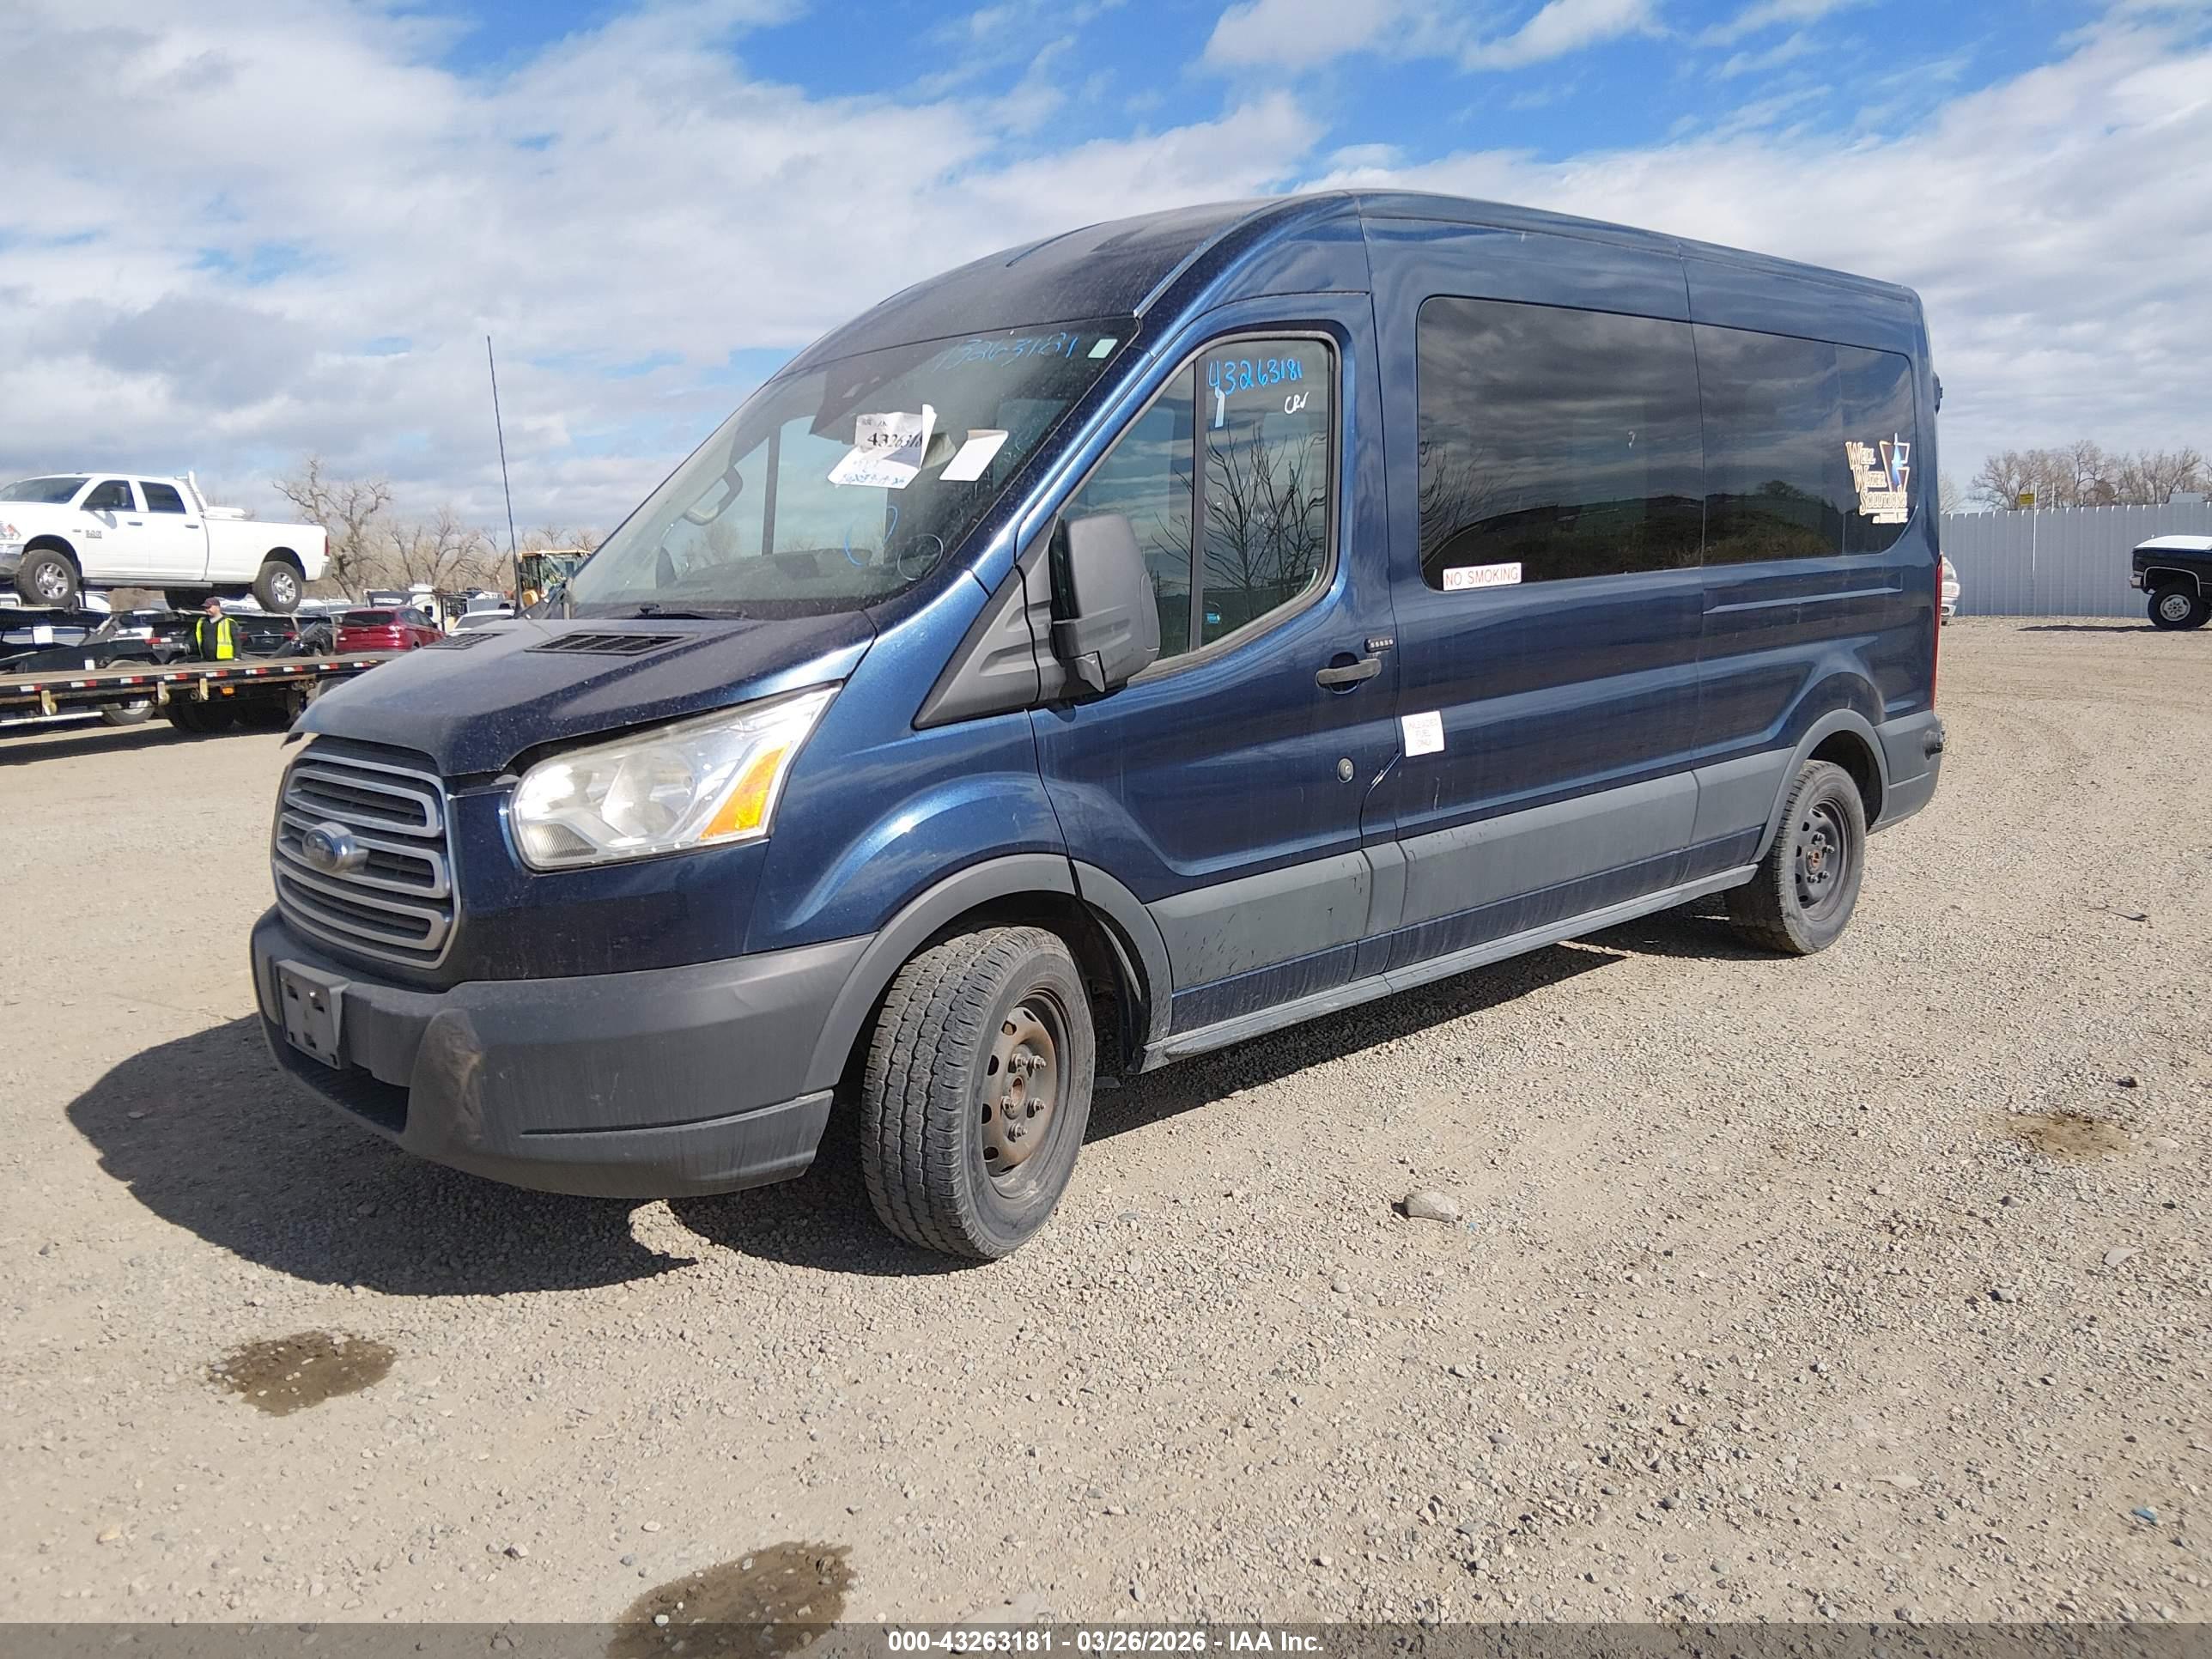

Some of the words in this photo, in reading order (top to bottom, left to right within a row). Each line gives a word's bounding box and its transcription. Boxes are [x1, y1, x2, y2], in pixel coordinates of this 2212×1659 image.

[1208, 358, 1303, 397] 43263181
[1445, 572, 1462, 586] NO
[1468, 567, 1518, 585] SMOKING
